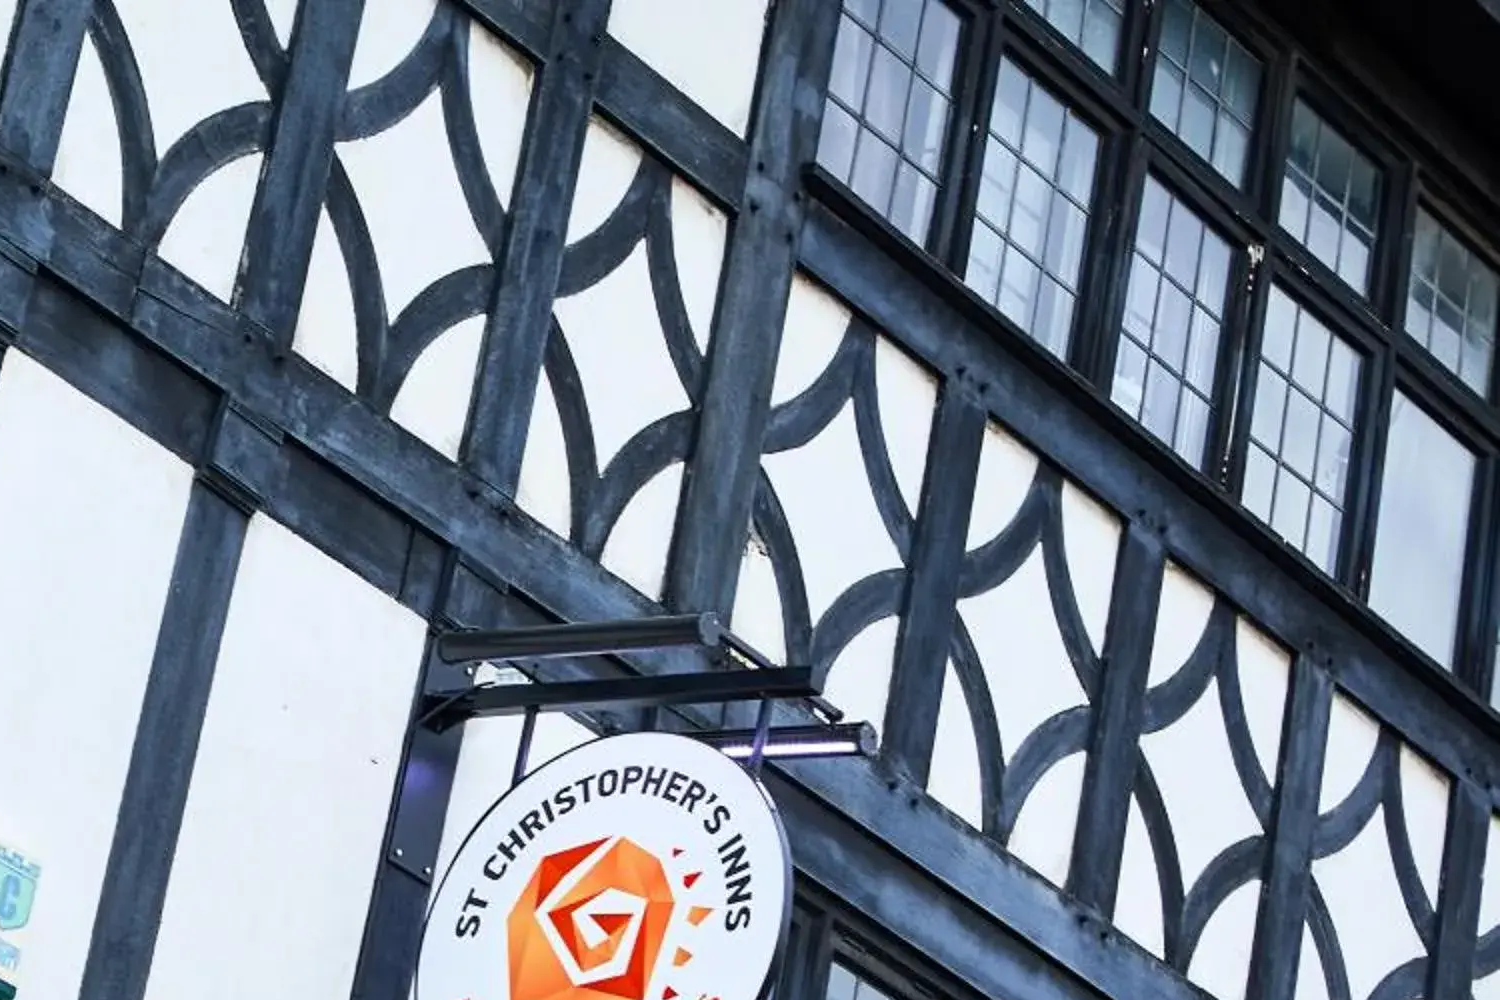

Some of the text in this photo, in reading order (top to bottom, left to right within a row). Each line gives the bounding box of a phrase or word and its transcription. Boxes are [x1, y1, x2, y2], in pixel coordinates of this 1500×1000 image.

[455, 765, 753, 939] ST CHRISTOPHER'S INNS
